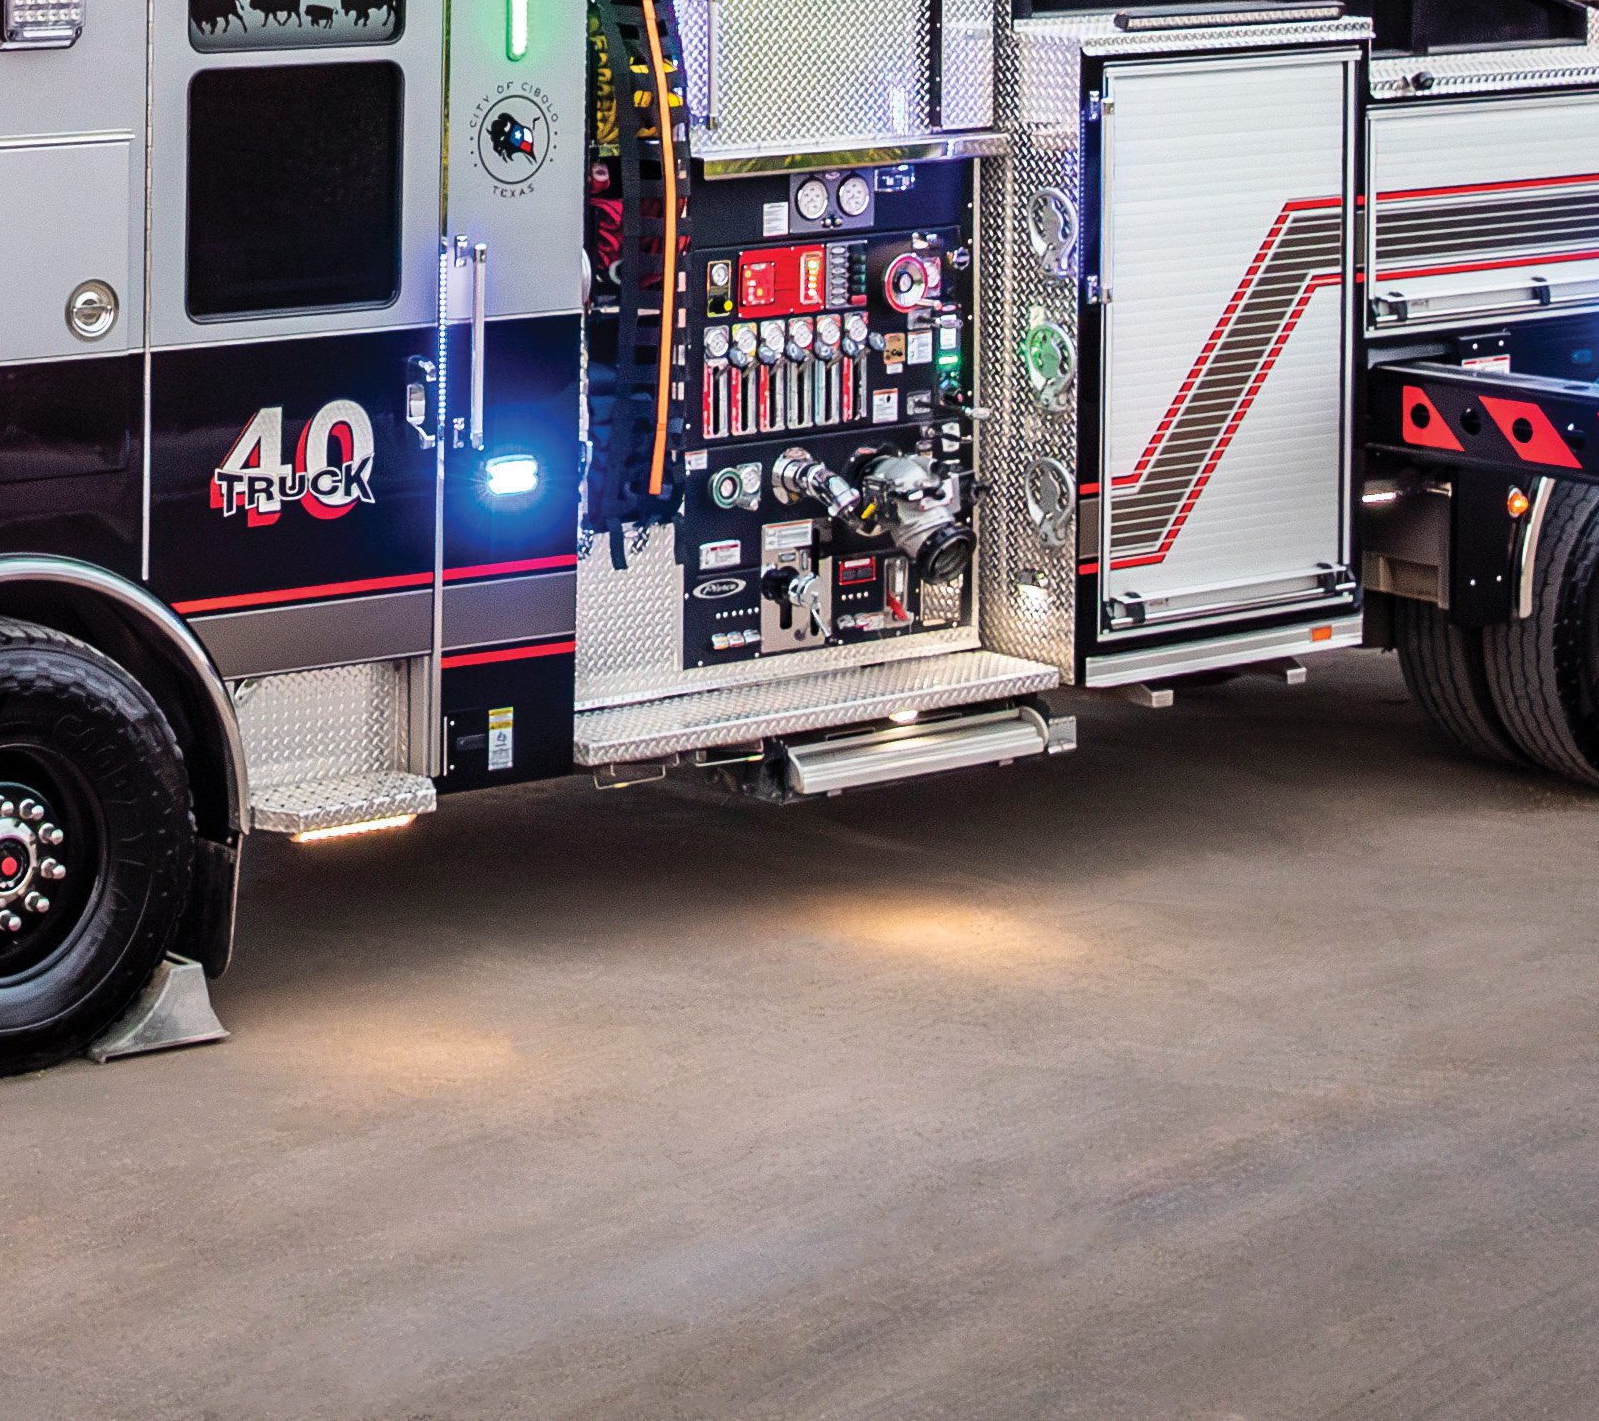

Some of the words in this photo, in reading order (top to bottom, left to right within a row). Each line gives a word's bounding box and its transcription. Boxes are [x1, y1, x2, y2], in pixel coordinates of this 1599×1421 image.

[469, 95, 489, 128] CITY
[496, 81, 514, 94] OF
[521, 82, 559, 122] CIBOLO
[492, 183, 535, 198] TEXAS
[212, 399, 374, 523] 40
[214, 452, 375, 517] TRUCK
